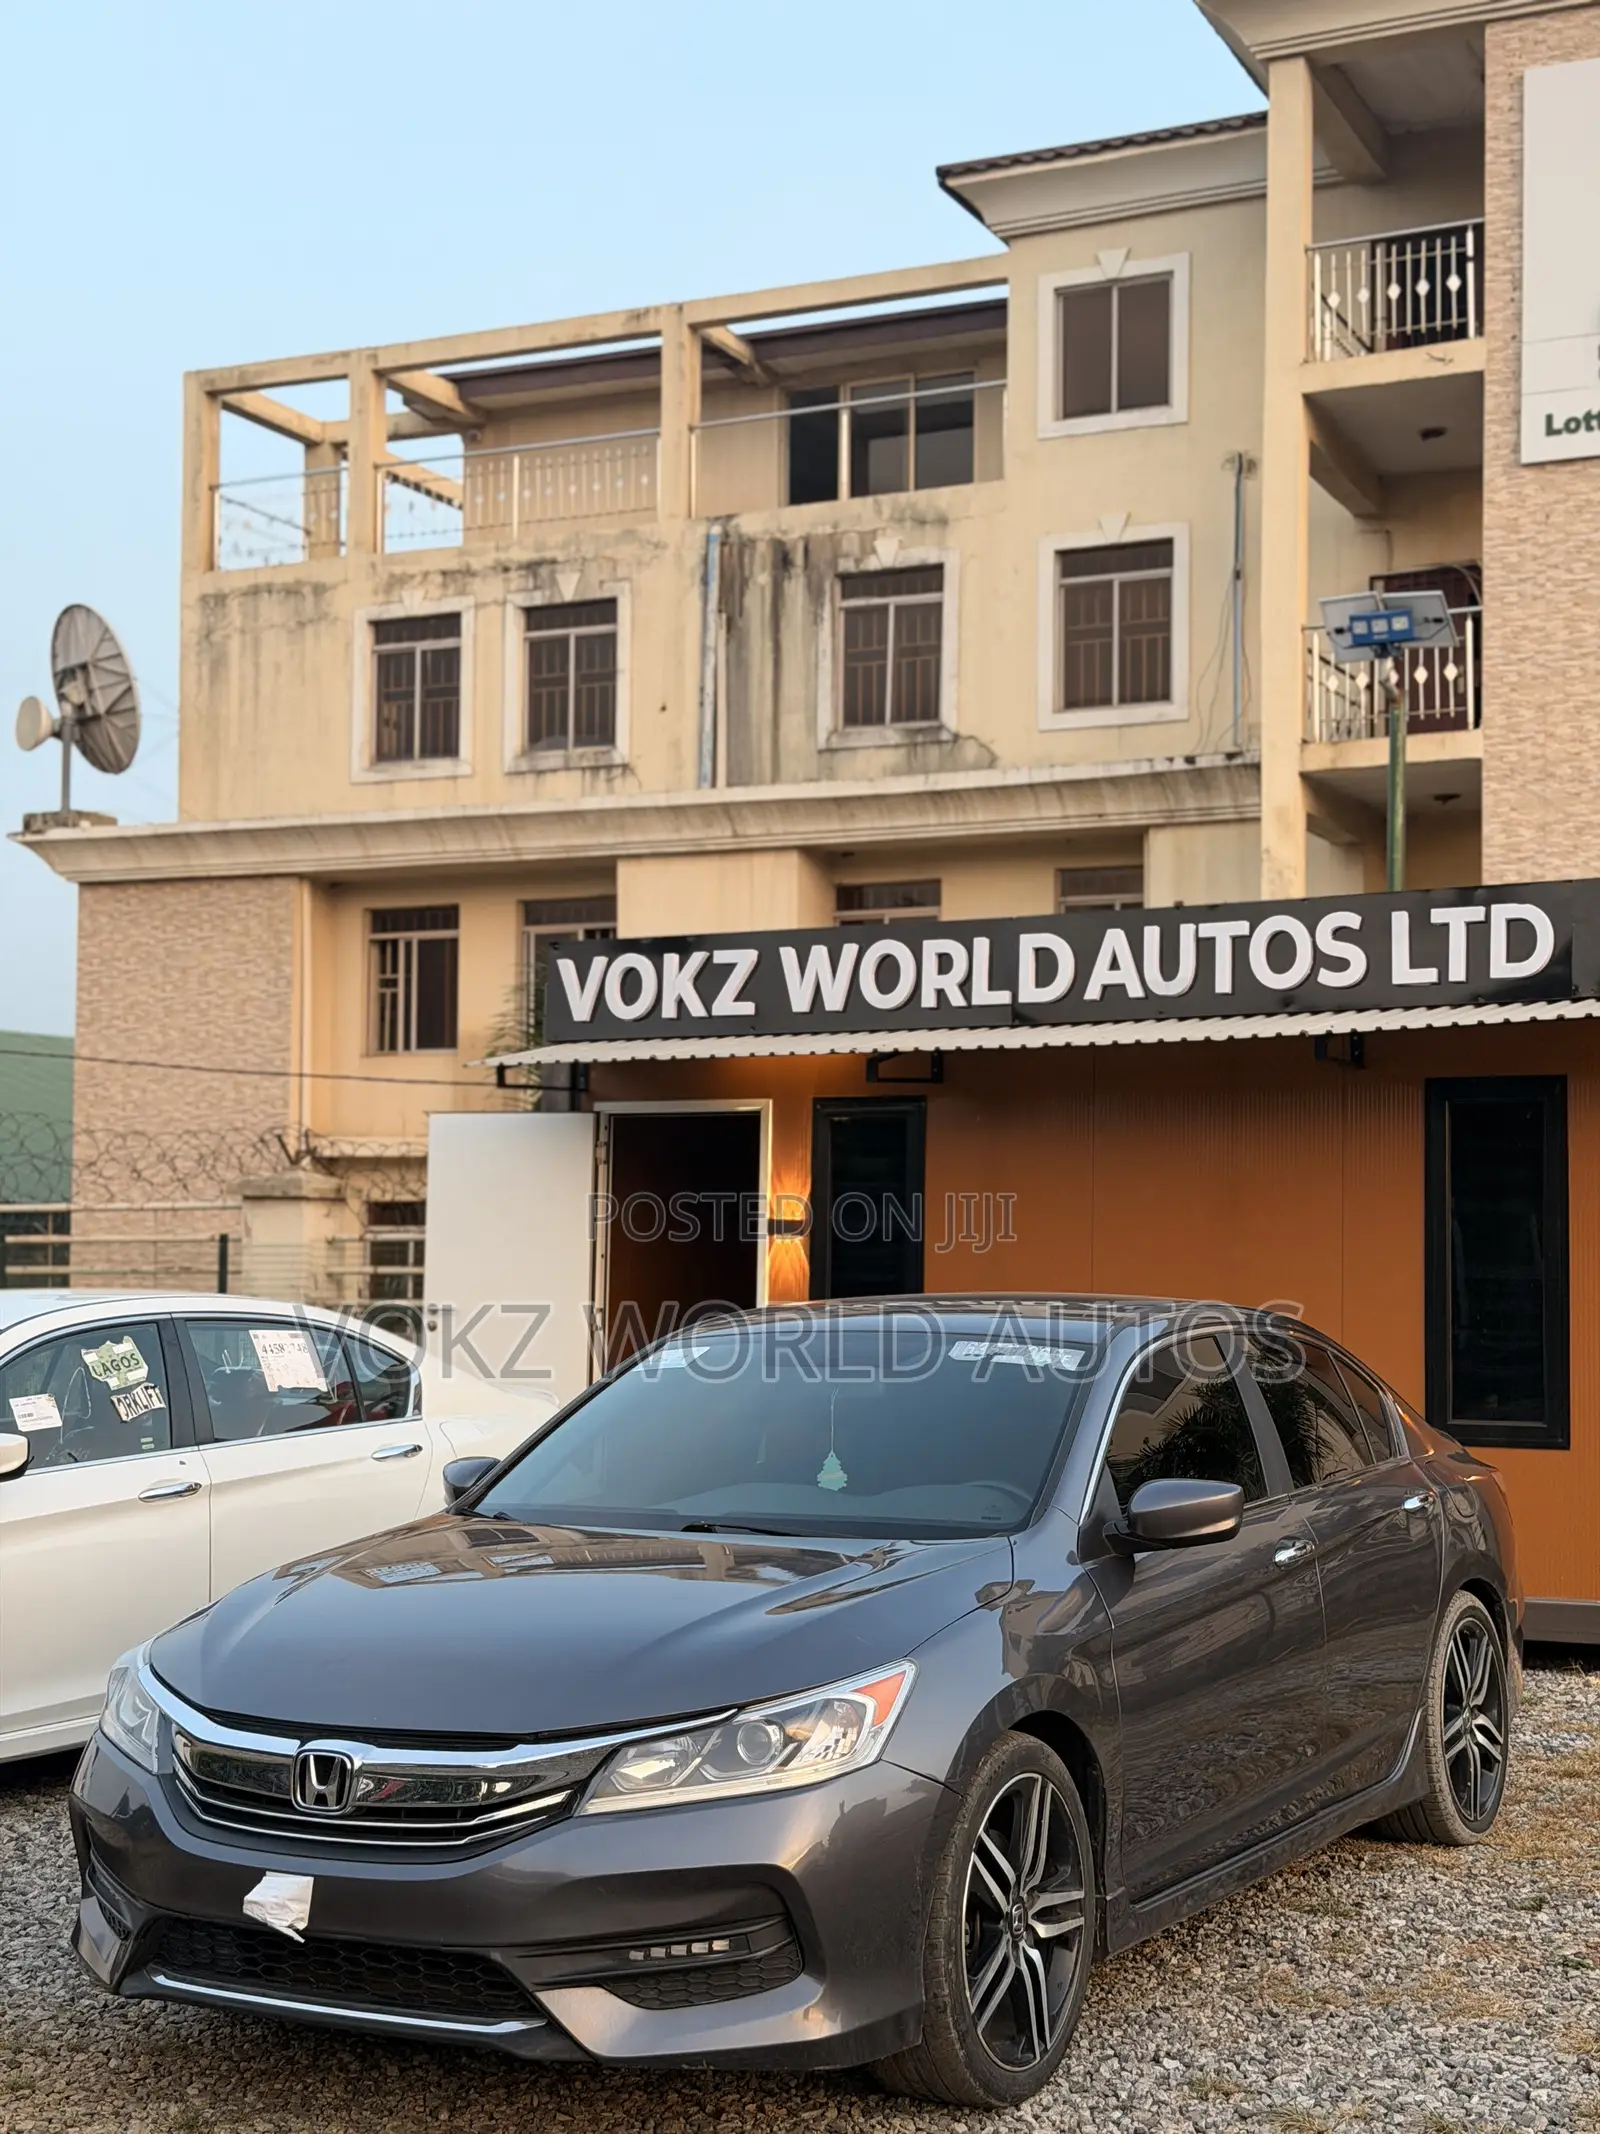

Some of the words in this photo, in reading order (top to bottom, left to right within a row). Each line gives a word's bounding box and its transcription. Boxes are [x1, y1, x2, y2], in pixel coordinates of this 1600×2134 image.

[556, 948, 760, 1022] VOKZ
[778, 932, 1077, 1014] WORLD
[1083, 911, 1368, 1001] AUTOS
[1390, 903, 1555, 986] LTD
[91, 1353, 141, 1378] LAGOS
